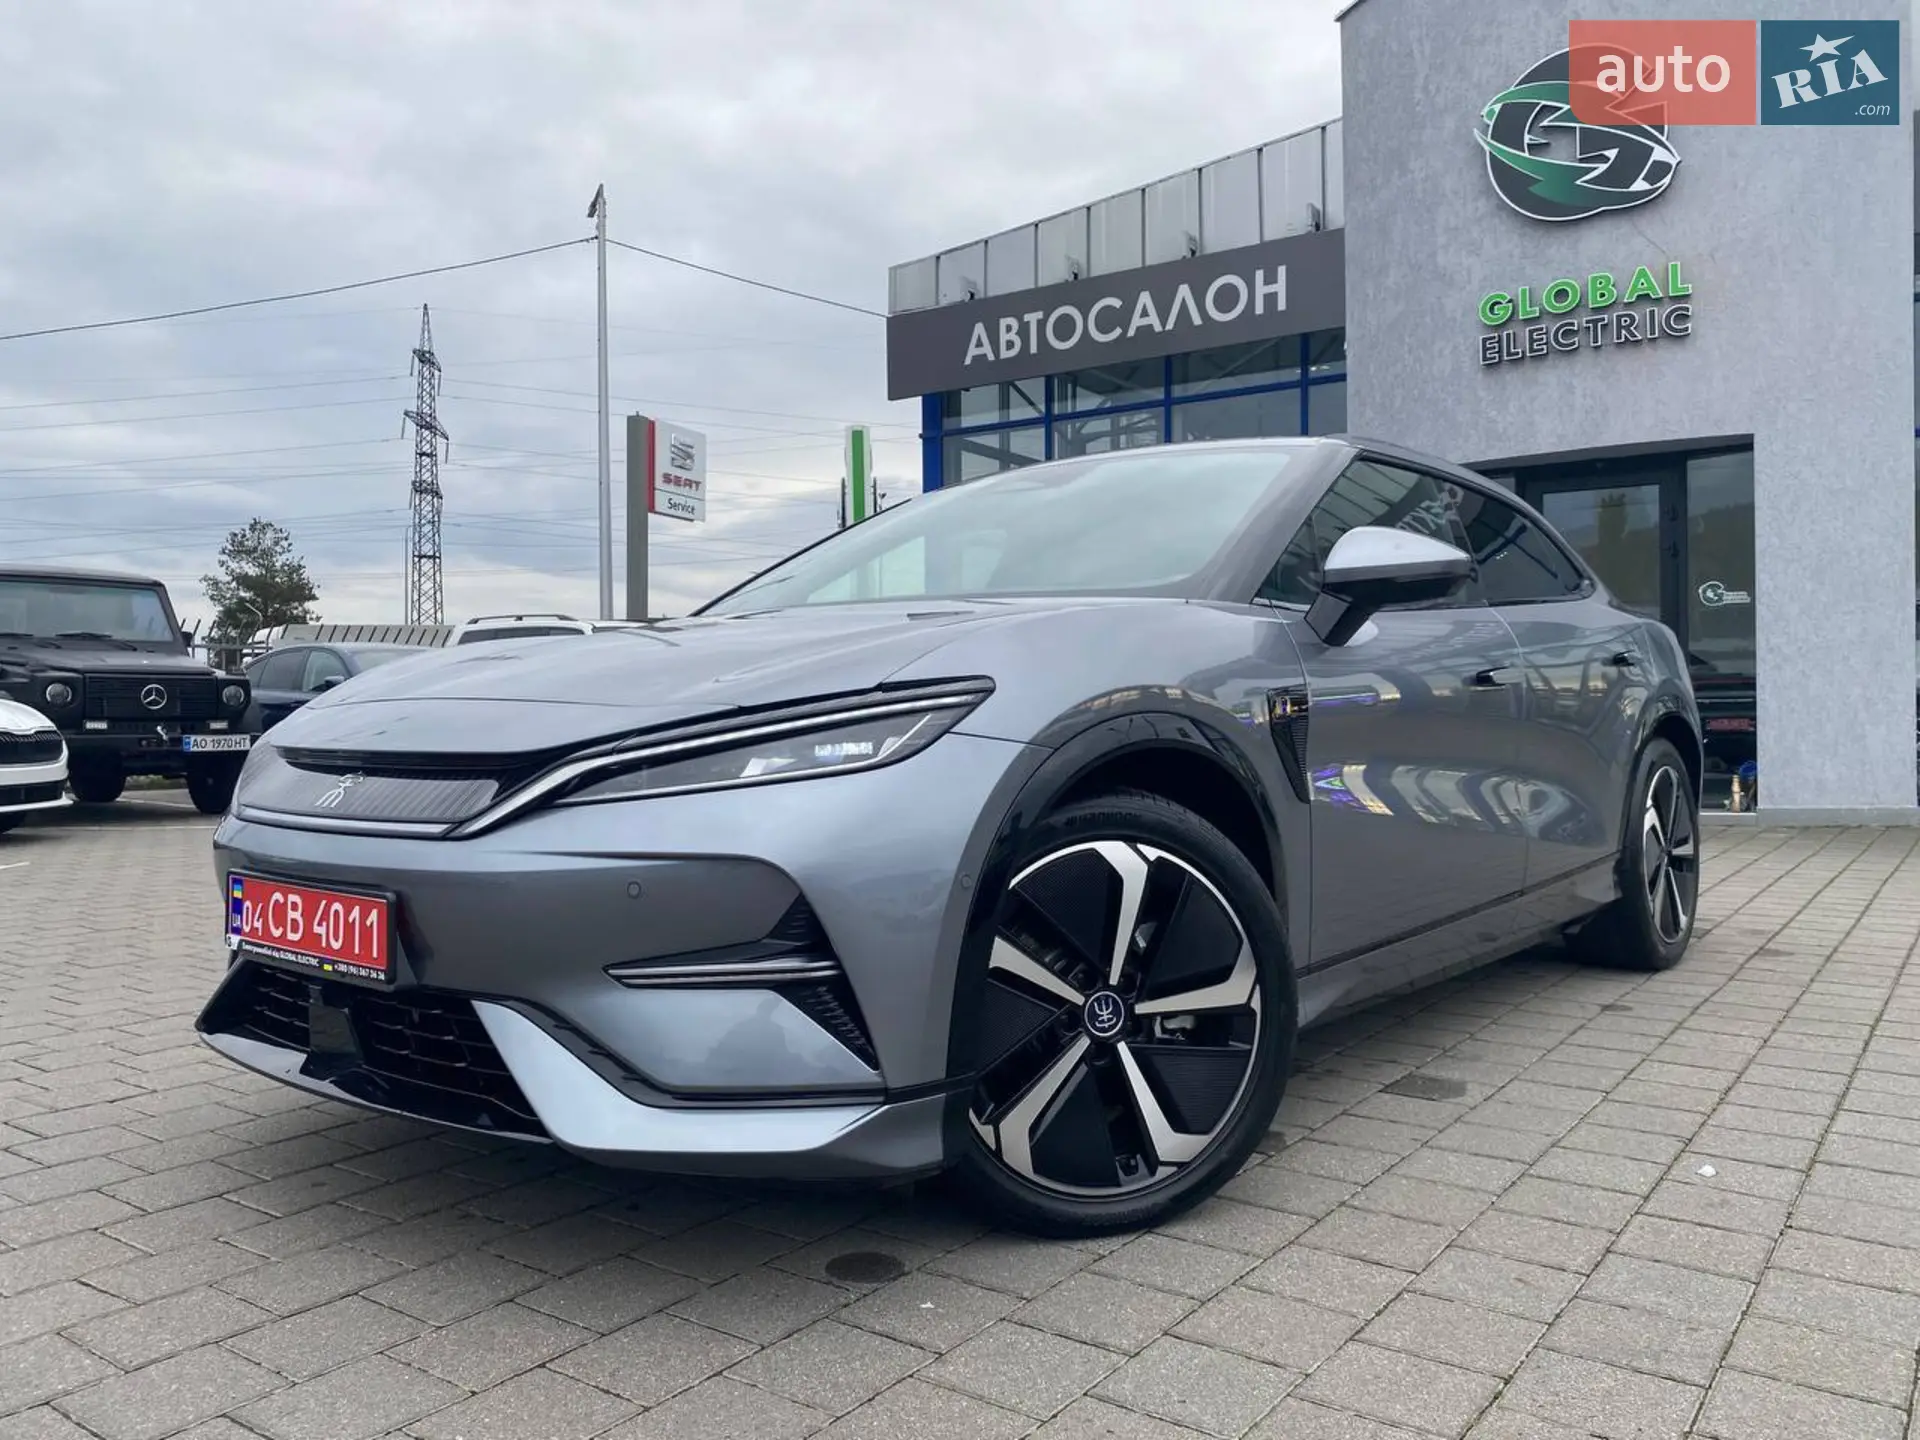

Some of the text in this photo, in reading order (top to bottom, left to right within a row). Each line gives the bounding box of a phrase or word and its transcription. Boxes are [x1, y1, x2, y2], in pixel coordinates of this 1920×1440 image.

[963, 265, 1287, 365] АВТОСАЛОН
[1478, 261, 1693, 326] GLOBAL
[1479, 304, 1693, 366] ELECTRIC
[662, 472, 702, 491] SEAT
[667, 497, 696, 515] Service
[192, 738, 208, 749] AO
[313, 900, 379, 958] 4011
